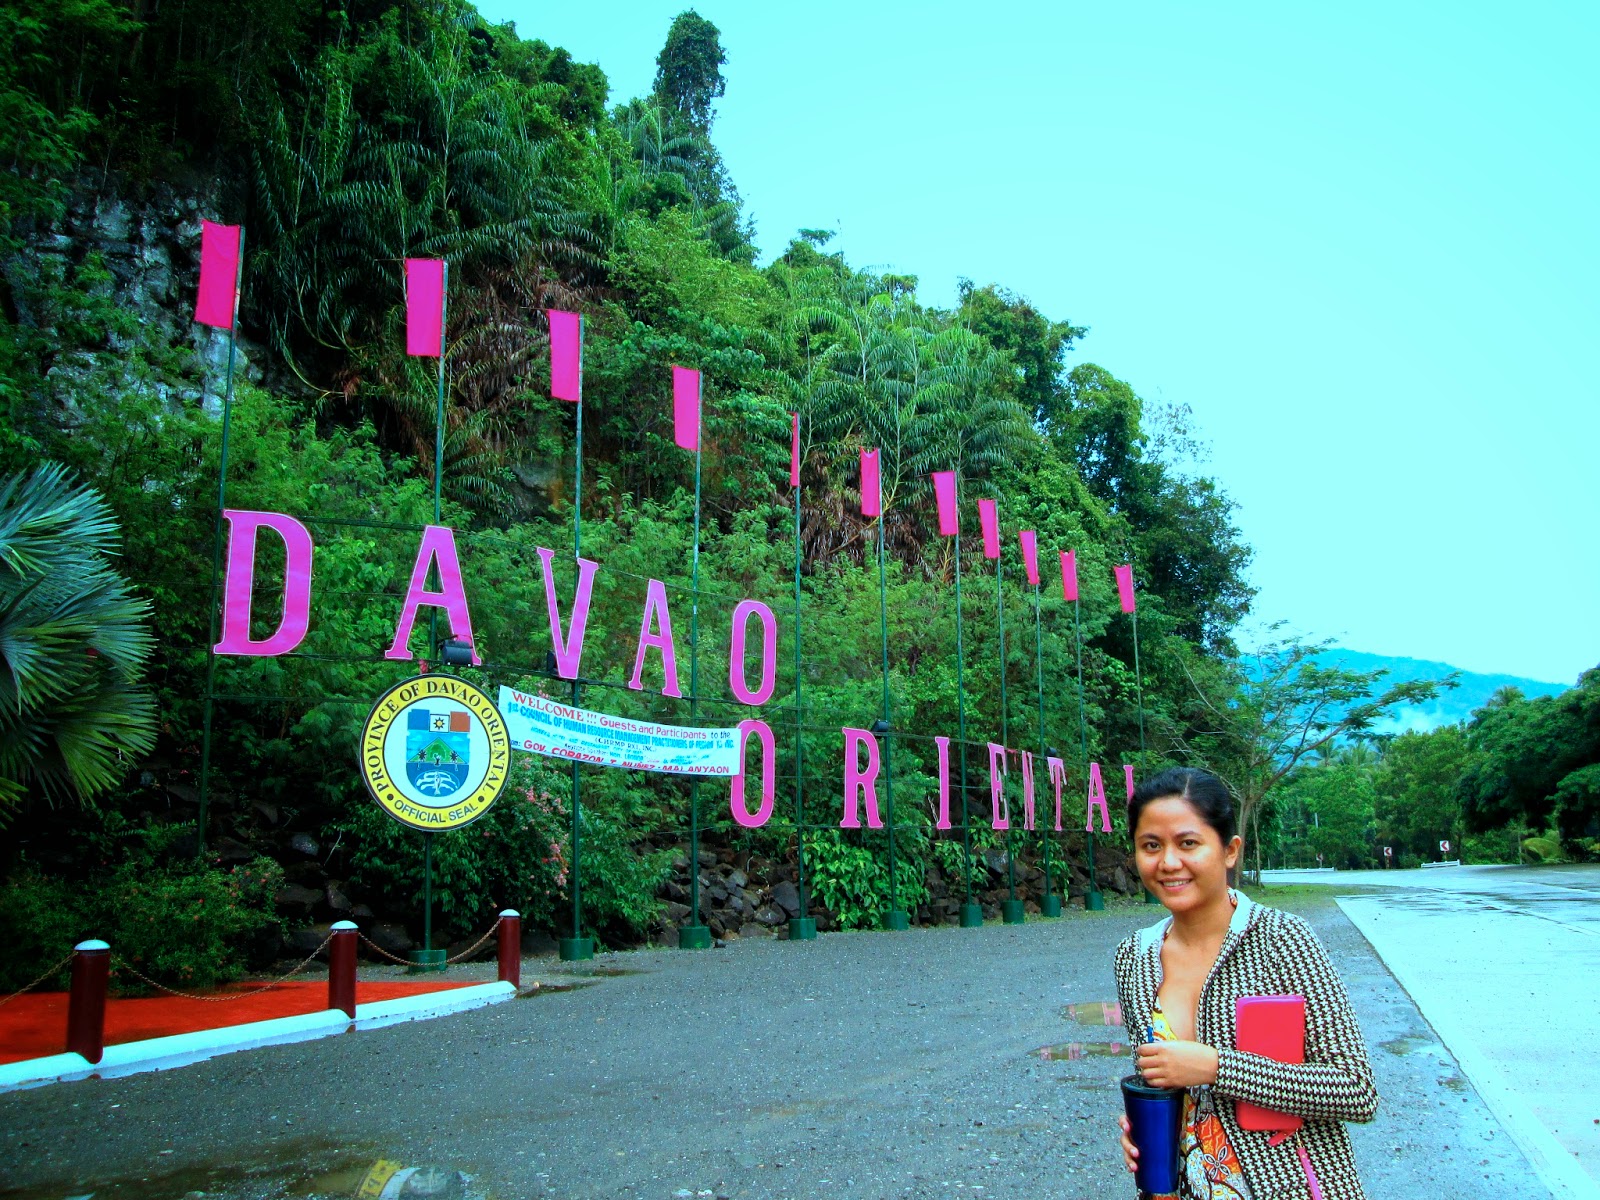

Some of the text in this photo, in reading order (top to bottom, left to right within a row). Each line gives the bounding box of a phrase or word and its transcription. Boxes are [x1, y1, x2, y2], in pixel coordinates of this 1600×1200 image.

[213, 509, 777, 706] DAVAO
[367, 681, 506, 793] PROVINCE OF DAVAO ORIENTAL
[520, 705, 552, 725] COUNCIL
[553, 717, 564, 728] OF
[563, 718, 587, 735] HUMAN
[587, 723, 614, 739] RESOURCE
[615, 730, 651, 746] MANAGEMENT
[600, 716, 637, 732] Guests
[639, 725, 654, 735] and
[656, 726, 707, 740] Participants
[710, 731, 718, 739] to
[720, 730, 731, 739] the
[394, 799, 479, 823] OFFICIAL SEAL
